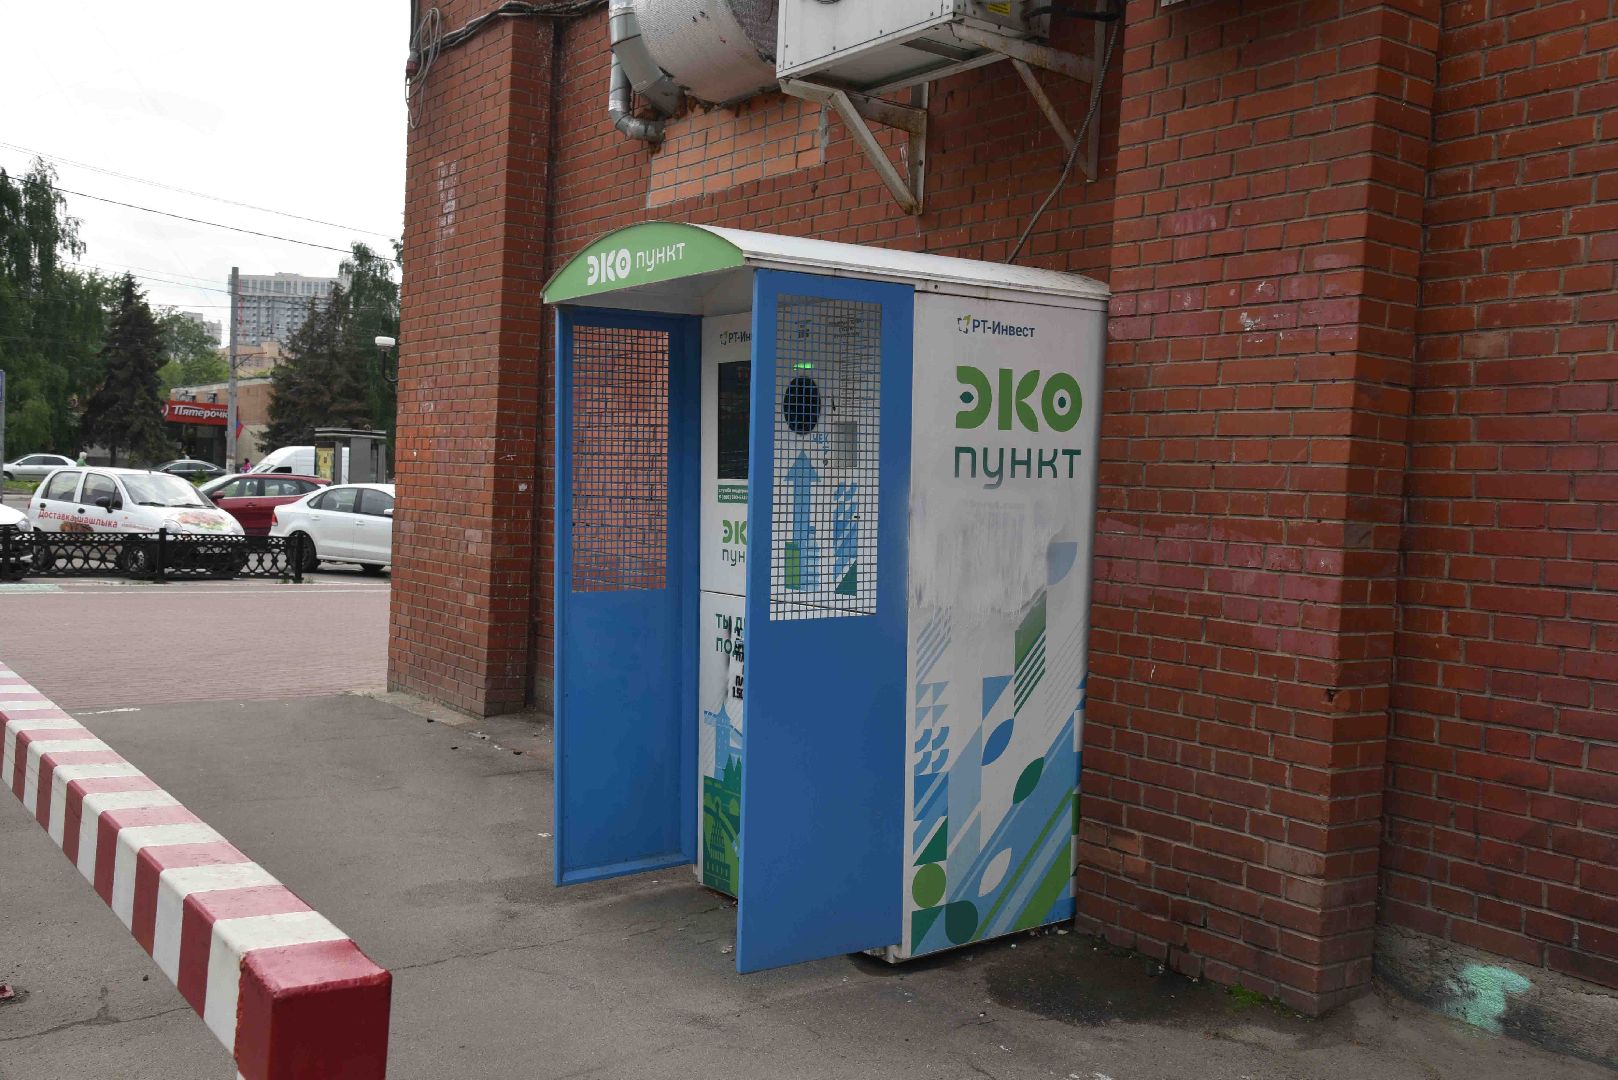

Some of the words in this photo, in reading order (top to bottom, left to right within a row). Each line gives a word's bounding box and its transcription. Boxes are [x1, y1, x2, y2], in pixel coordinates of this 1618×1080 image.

[587, 248, 632, 286] ЭКО
[972, 319, 1036, 338] РТ-Инвест
[955, 365, 1083, 433] ЭКО
[76, 514, 118, 529] шашлыка
[722, 519, 749, 546] ЭК
[722, 548, 747, 567] пун
